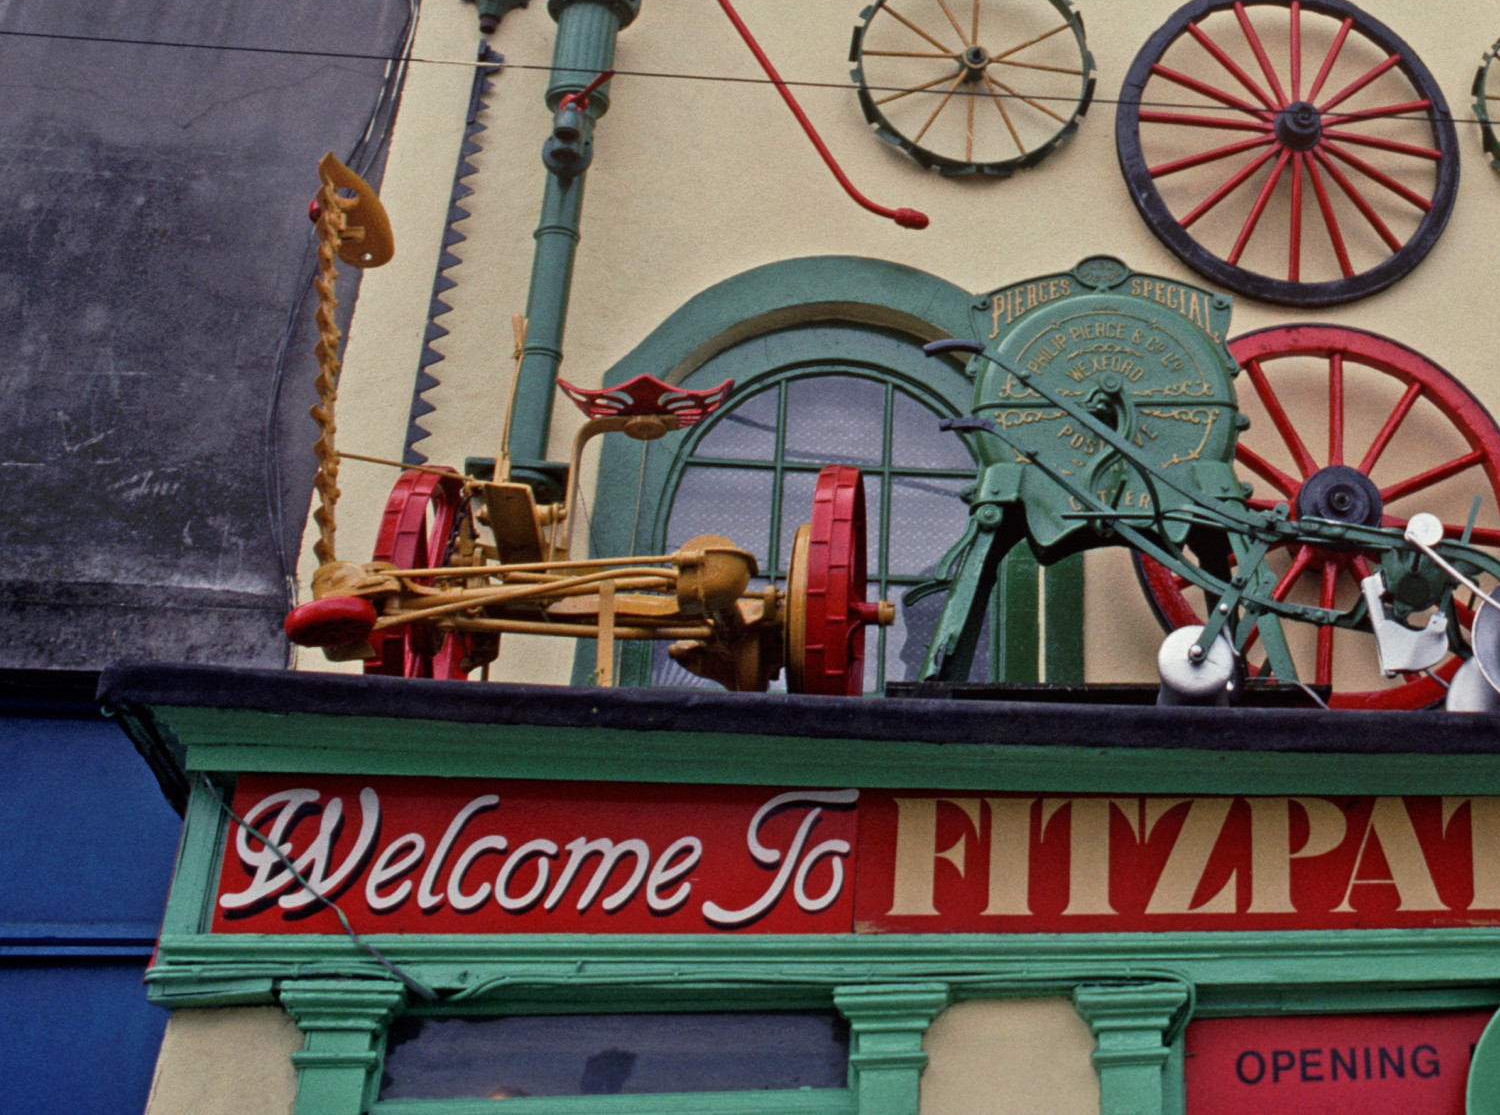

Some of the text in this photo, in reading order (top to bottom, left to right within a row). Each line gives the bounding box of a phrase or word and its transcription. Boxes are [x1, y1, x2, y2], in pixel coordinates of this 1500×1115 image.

[1131, 278, 1221, 345] SPECIAL
[1026, 333, 1067, 375] PHILIP
[1069, 322, 1127, 344] PIERCE
[1131, 328, 1144, 345] &
[1067, 355, 1145, 383] WEXFORD
[219, 787, 703, 911] Welcome
[702, 788, 860, 924] To
[1235, 1044, 1441, 1085] OPENING
